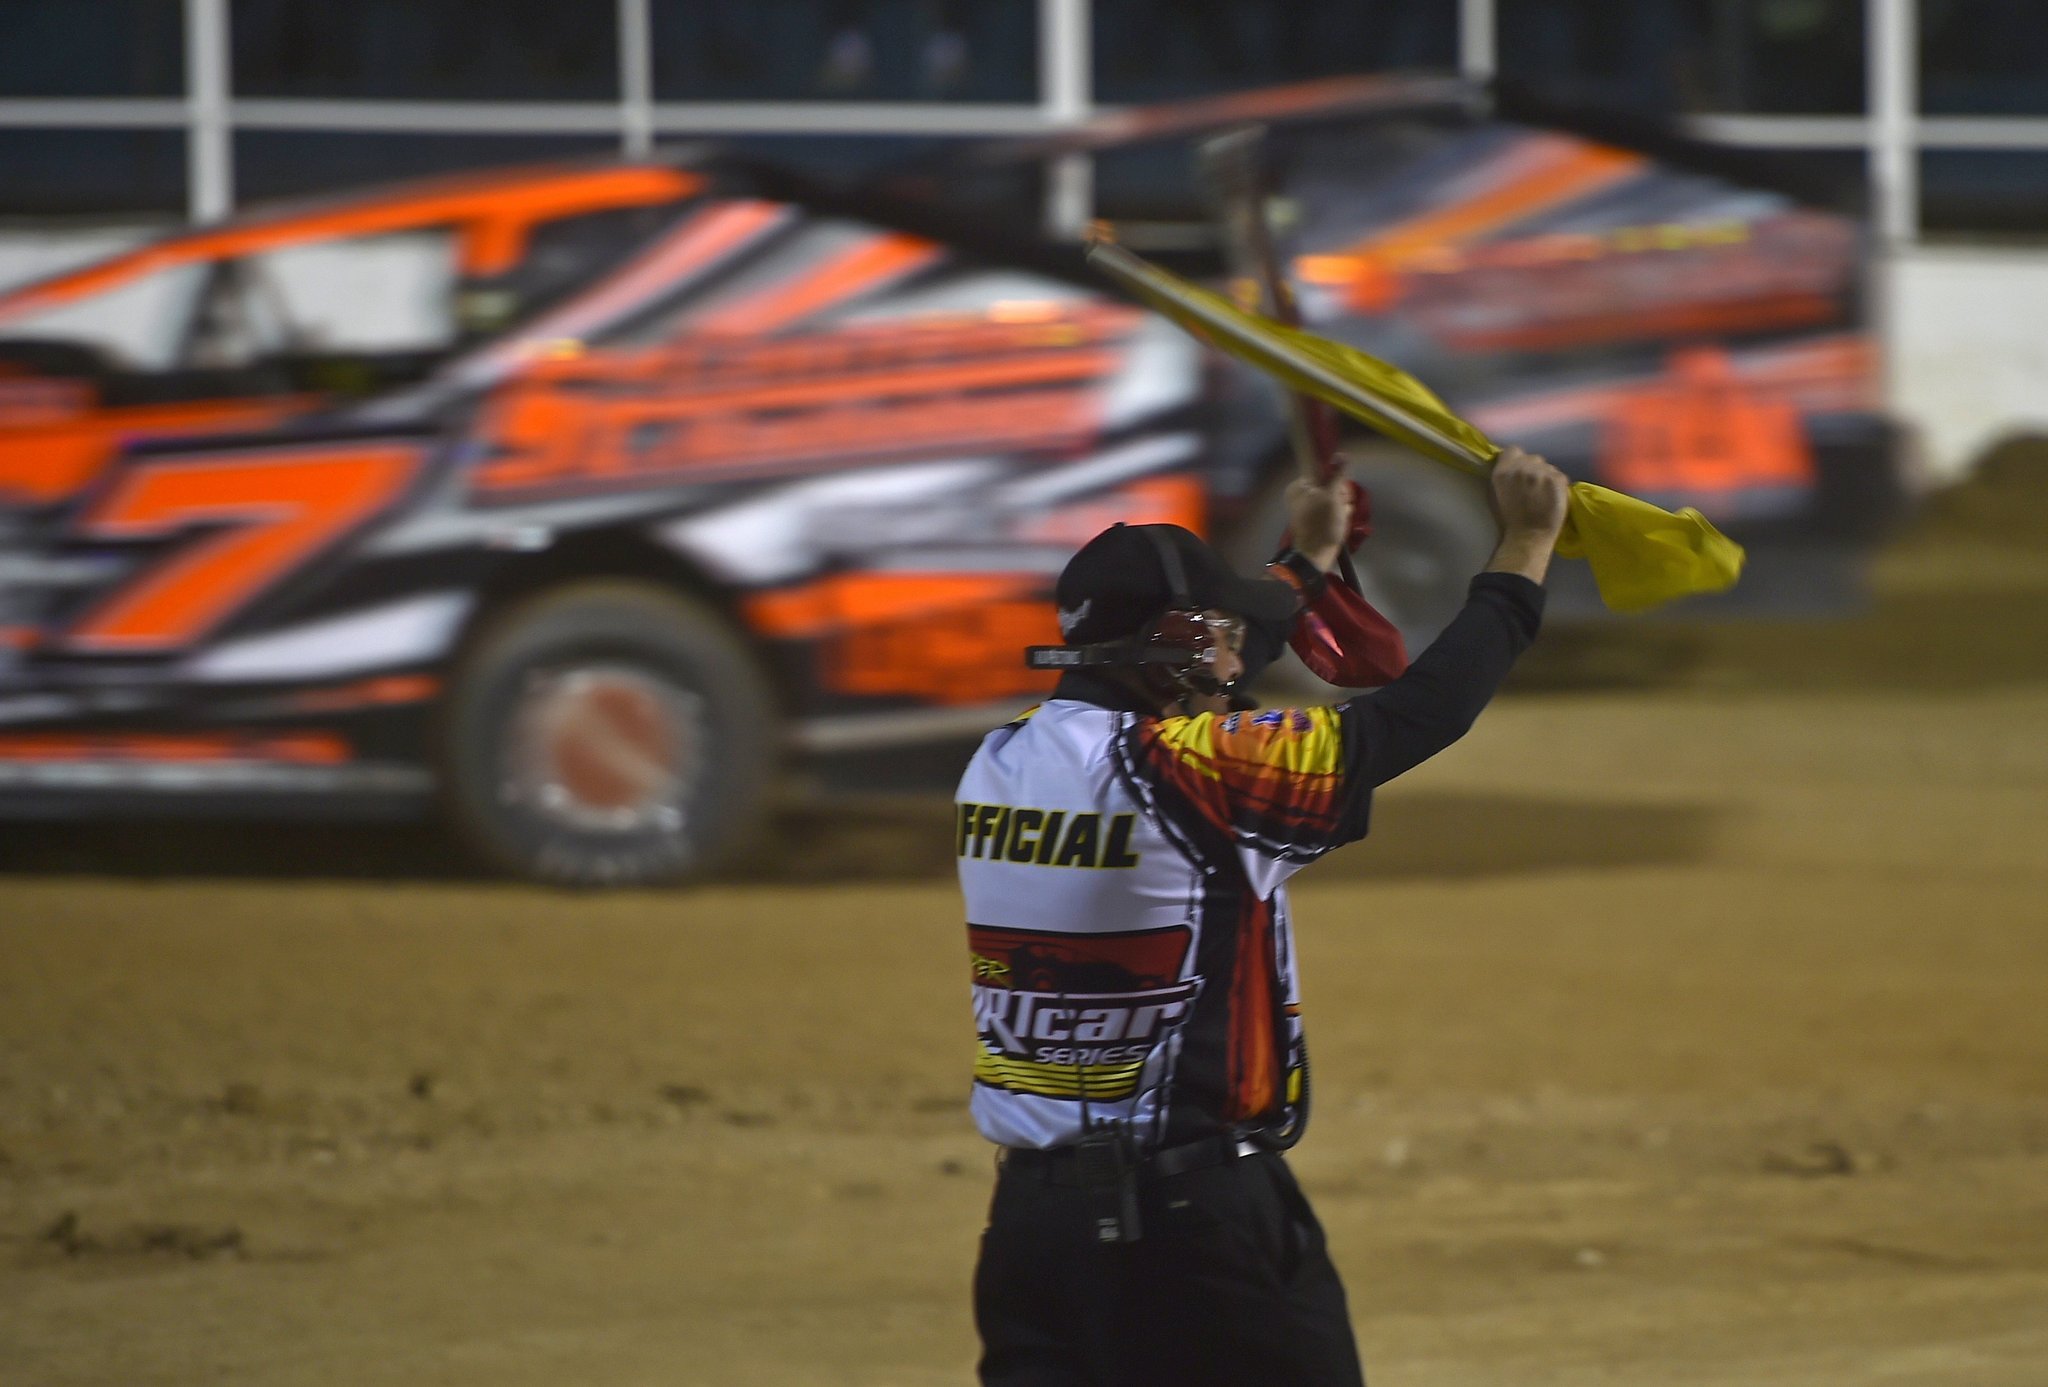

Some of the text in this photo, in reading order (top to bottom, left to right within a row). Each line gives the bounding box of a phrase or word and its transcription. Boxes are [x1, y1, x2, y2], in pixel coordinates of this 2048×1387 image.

[76, 446, 430, 650] 7
[957, 802, 1140, 869] FFICIAL
[1035, 1043, 1153, 1066] SERIES
